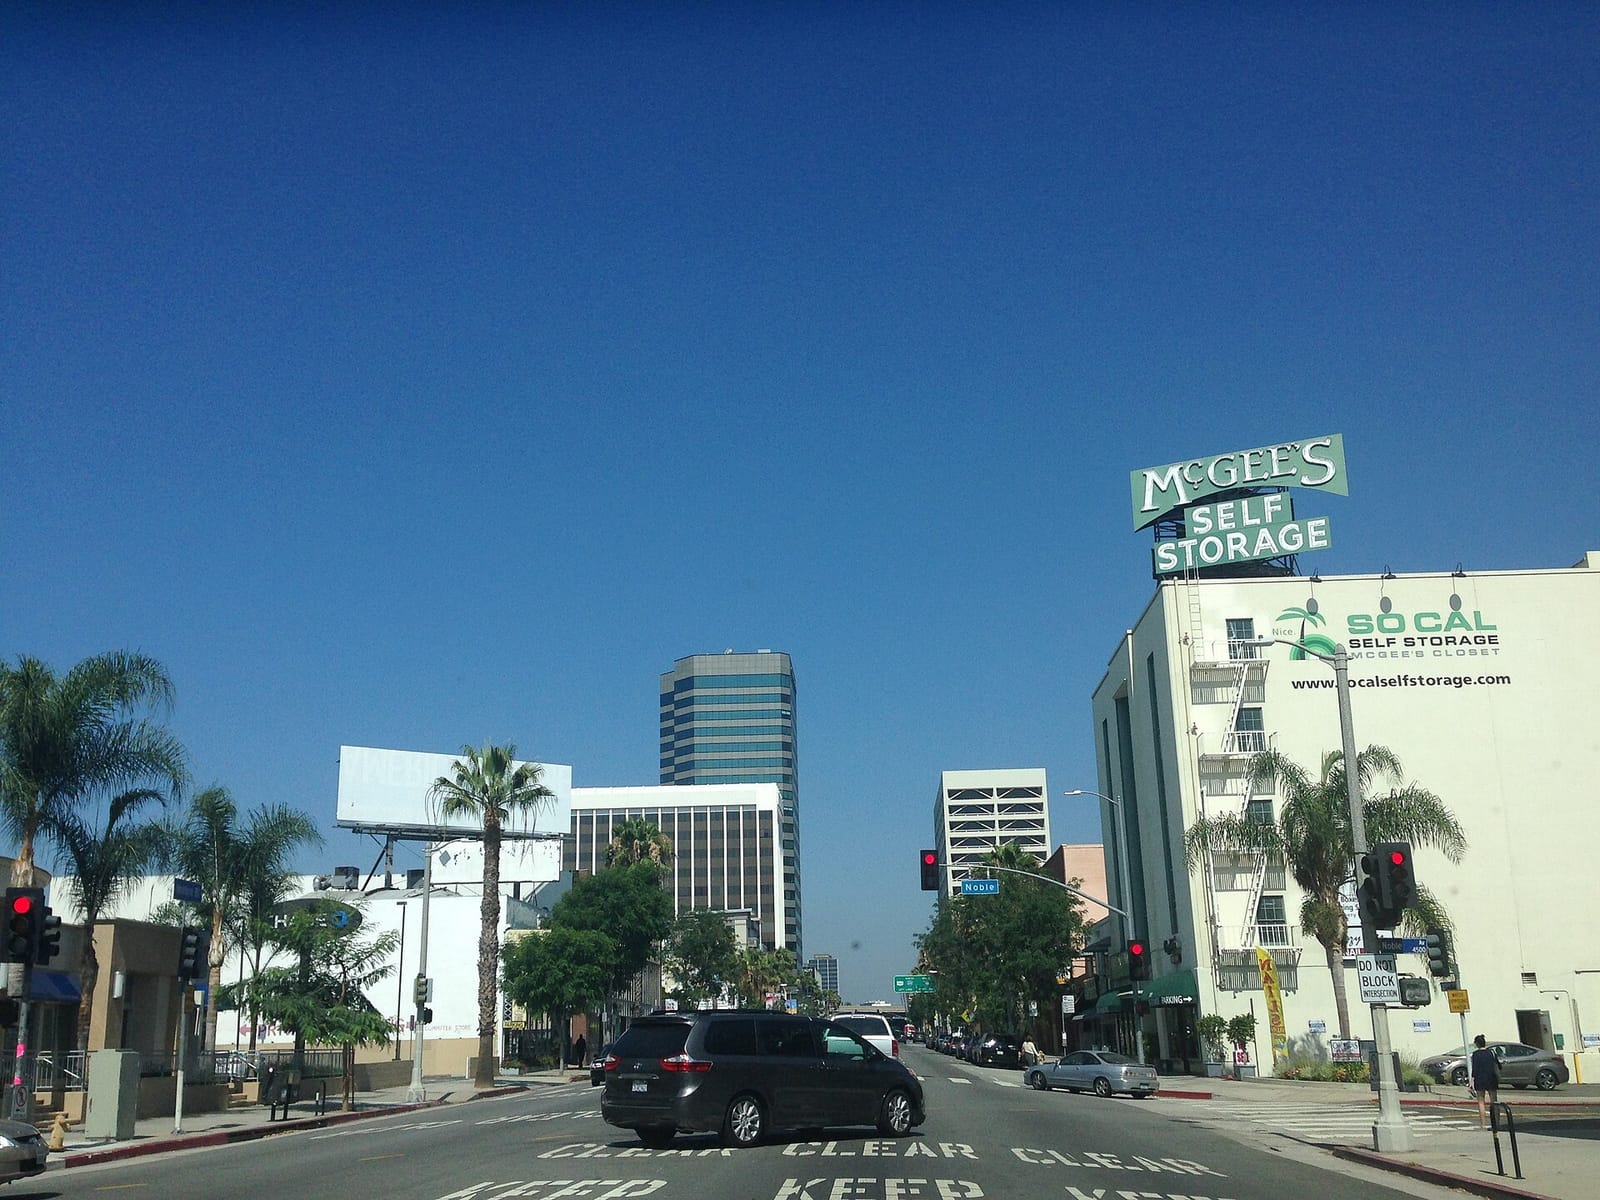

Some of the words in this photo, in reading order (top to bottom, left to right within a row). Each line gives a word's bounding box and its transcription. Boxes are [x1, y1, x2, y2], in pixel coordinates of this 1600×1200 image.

[1192, 494, 1282, 534] SELF
[1157, 518, 1328, 570] STORAGE
[1347, 613, 1406, 634] SO
[1414, 611, 1497, 632] CAL
[1349, 638, 1397, 649] SELF
[1404, 635, 1500, 647] STORAGE
[1433, 648, 1500, 657] CLOSET
[1291, 675, 1511, 690] www.ocalselfstorage.com
[965, 882, 995, 892] Noble
[1359, 960, 1372, 971] DO
[1375, 960, 1394, 971] NOT
[1362, 976, 1395, 987] BLOCK
[1161, 995, 1183, 1004] PARKING
[1363, 990, 1398, 998] INTERSECTION
[781, 1140, 979, 1160] CLEAR
[1010, 1147, 1229, 1178] CLEAR
[434, 1179, 668, 1200] KEEP
[773, 1178, 985, 1200] KEEP
